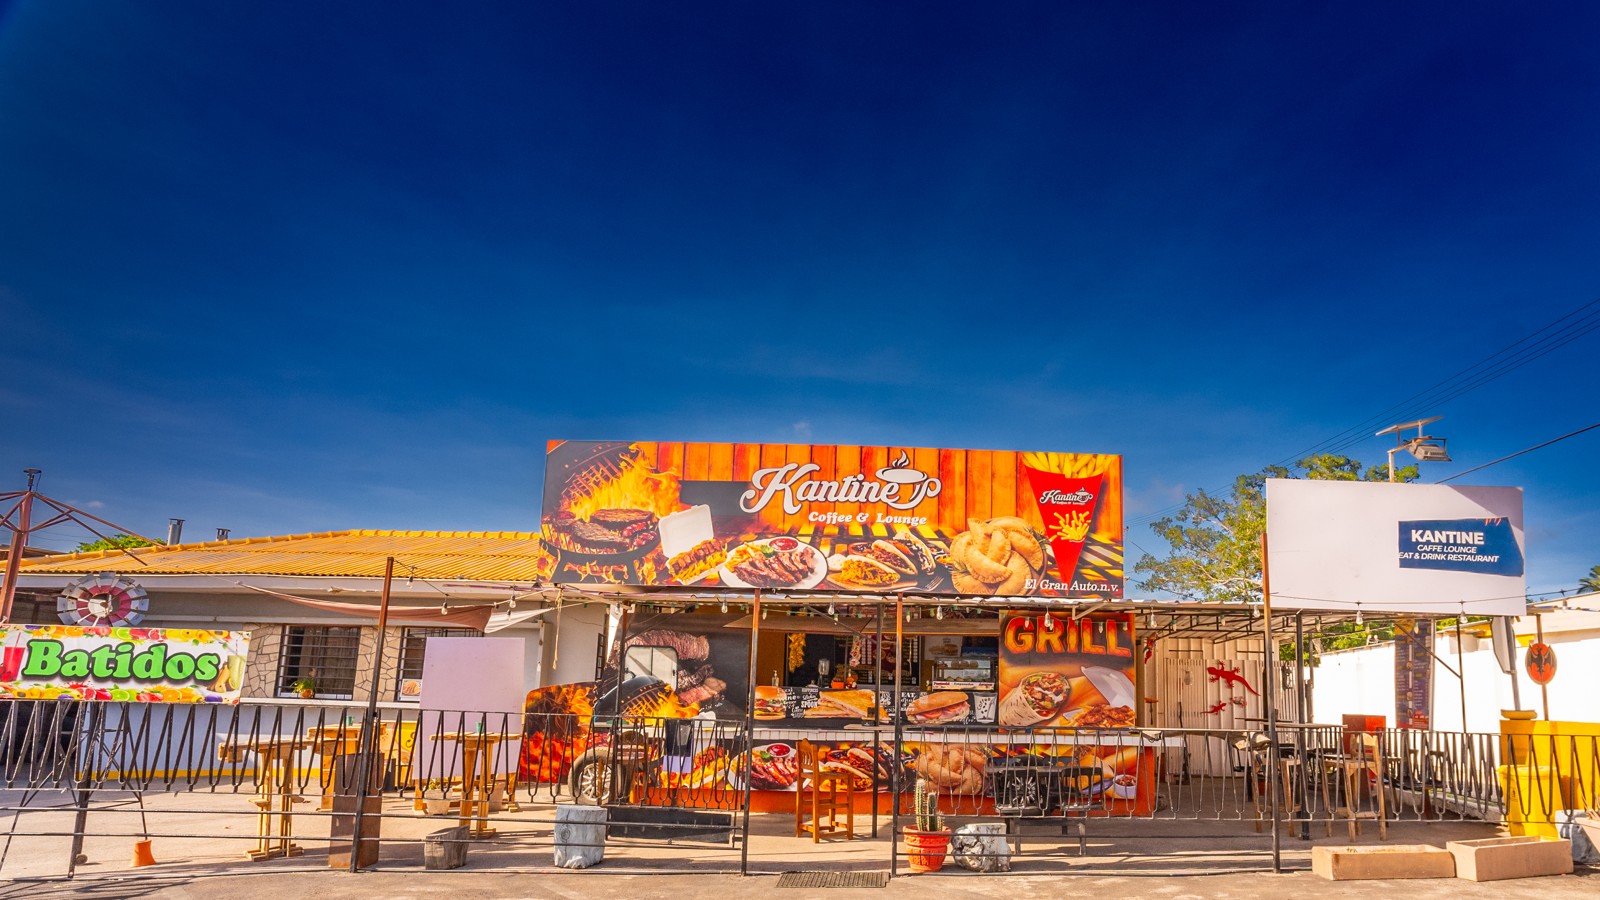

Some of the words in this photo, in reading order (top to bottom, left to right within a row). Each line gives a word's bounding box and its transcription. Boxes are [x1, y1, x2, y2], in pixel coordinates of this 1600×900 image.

[739, 462, 903, 515] Kantine
[1039, 489, 1083, 505] Kantine
[808, 511, 852, 524] Coffee
[856, 513, 869, 523] &
[876, 513, 927, 526] Lounge
[1411, 529, 1485, 545] KANTINE
[1417, 544, 1443, 552] CAFFE
[1443, 545, 1477, 554] LOUNGE
[1413, 552, 1420, 560] &
[1421, 553, 1446, 561] DRINK
[1447, 554, 1499, 563] RESTAURANT
[1023, 579, 1036, 590] El
[1039, 579, 1069, 591] Gran
[1005, 615, 1132, 657] GRILL
[22, 639, 220, 681] Batidos
